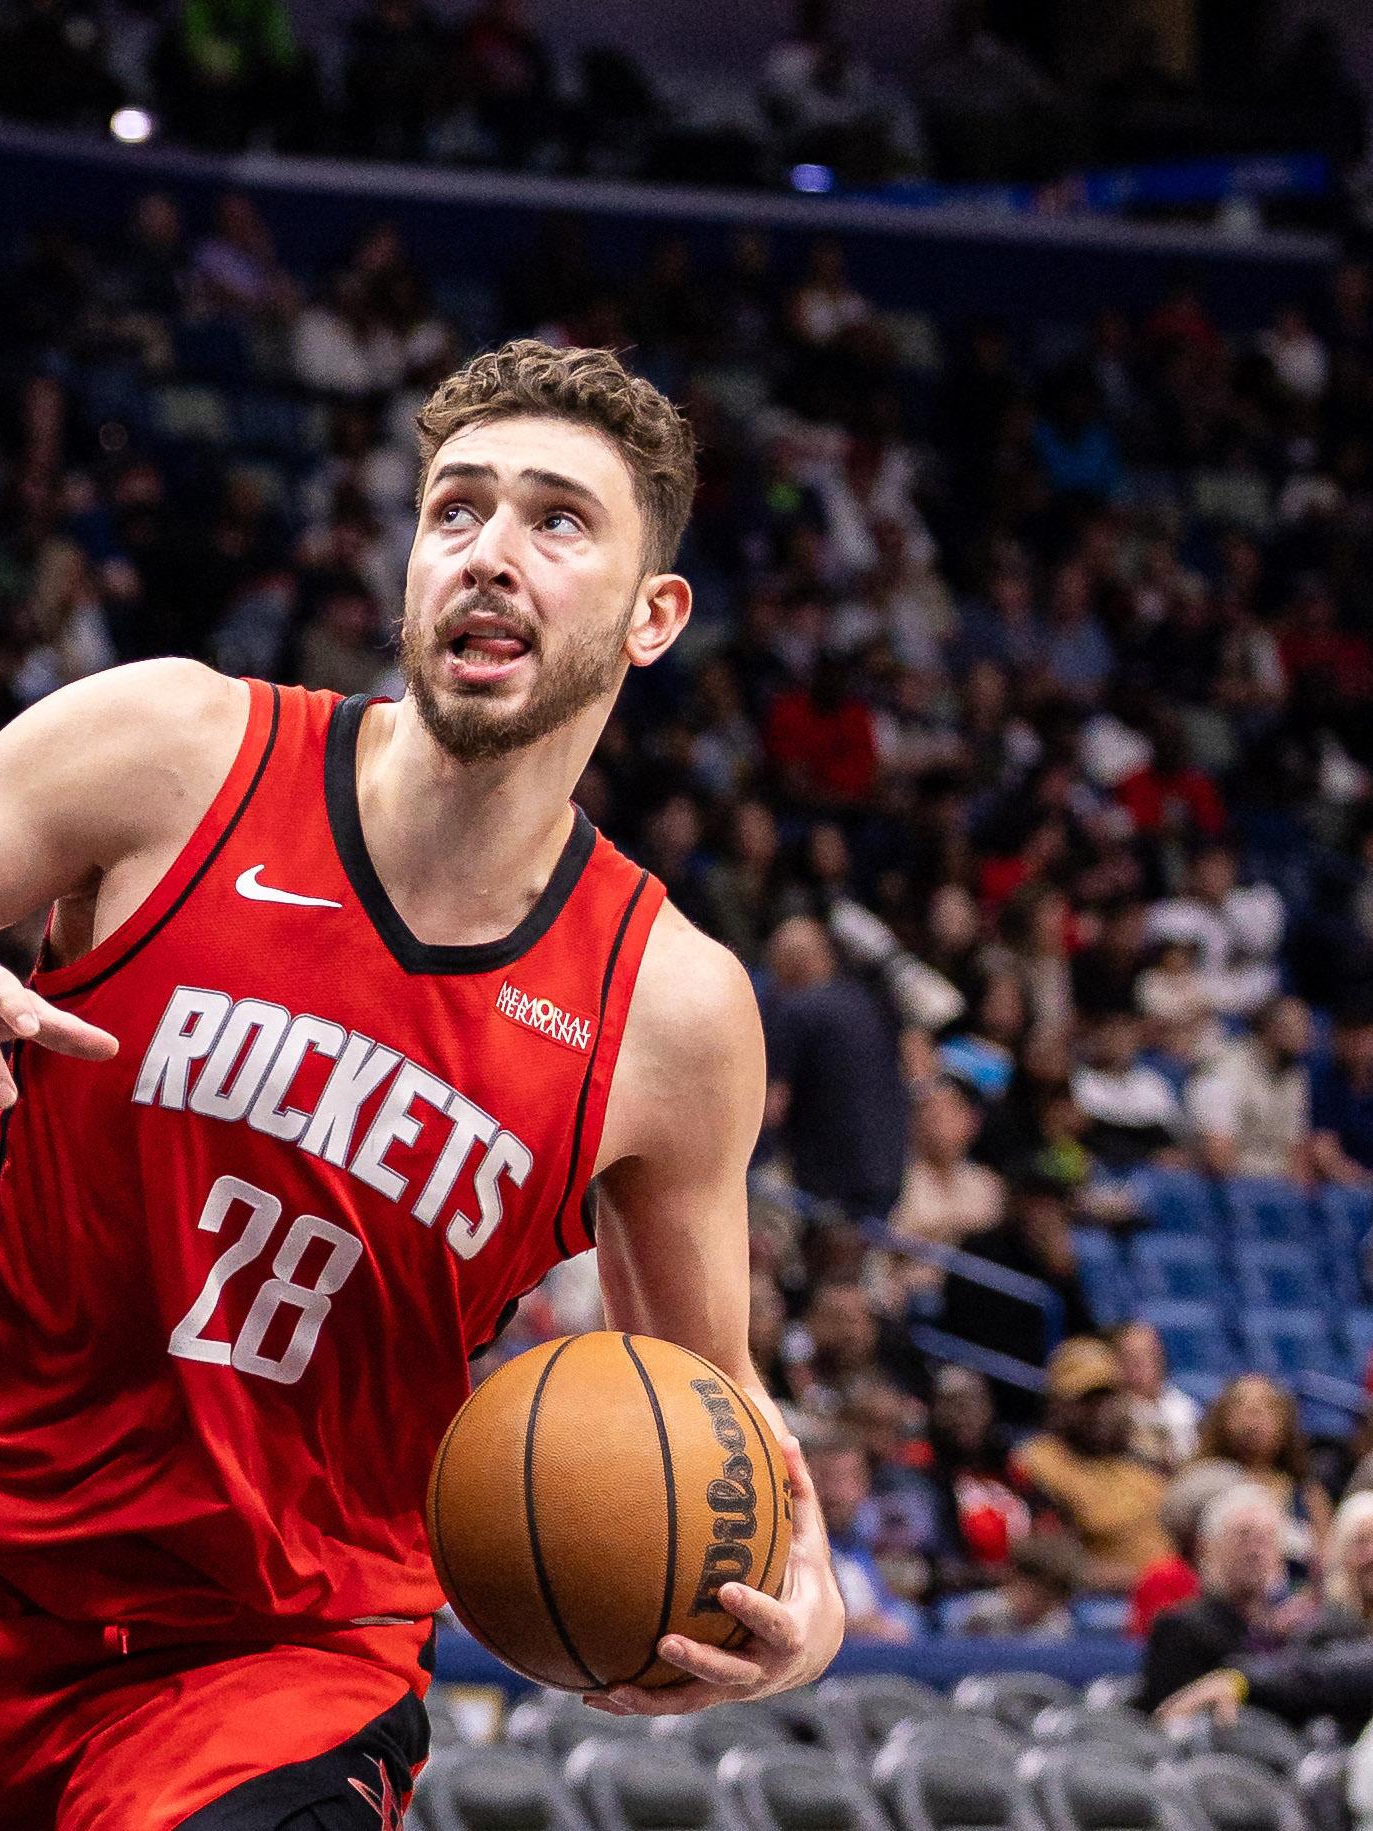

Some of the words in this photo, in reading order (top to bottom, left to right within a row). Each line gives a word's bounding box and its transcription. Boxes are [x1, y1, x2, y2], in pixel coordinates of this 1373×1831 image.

[495, 980, 592, 1038] MEMORIAL
[497, 996, 591, 1050] HERMANN
[131, 985, 534, 1261] ROCKETS
[167, 1174, 364, 1385] 28
[689, 1378, 758, 1617] Wilson
